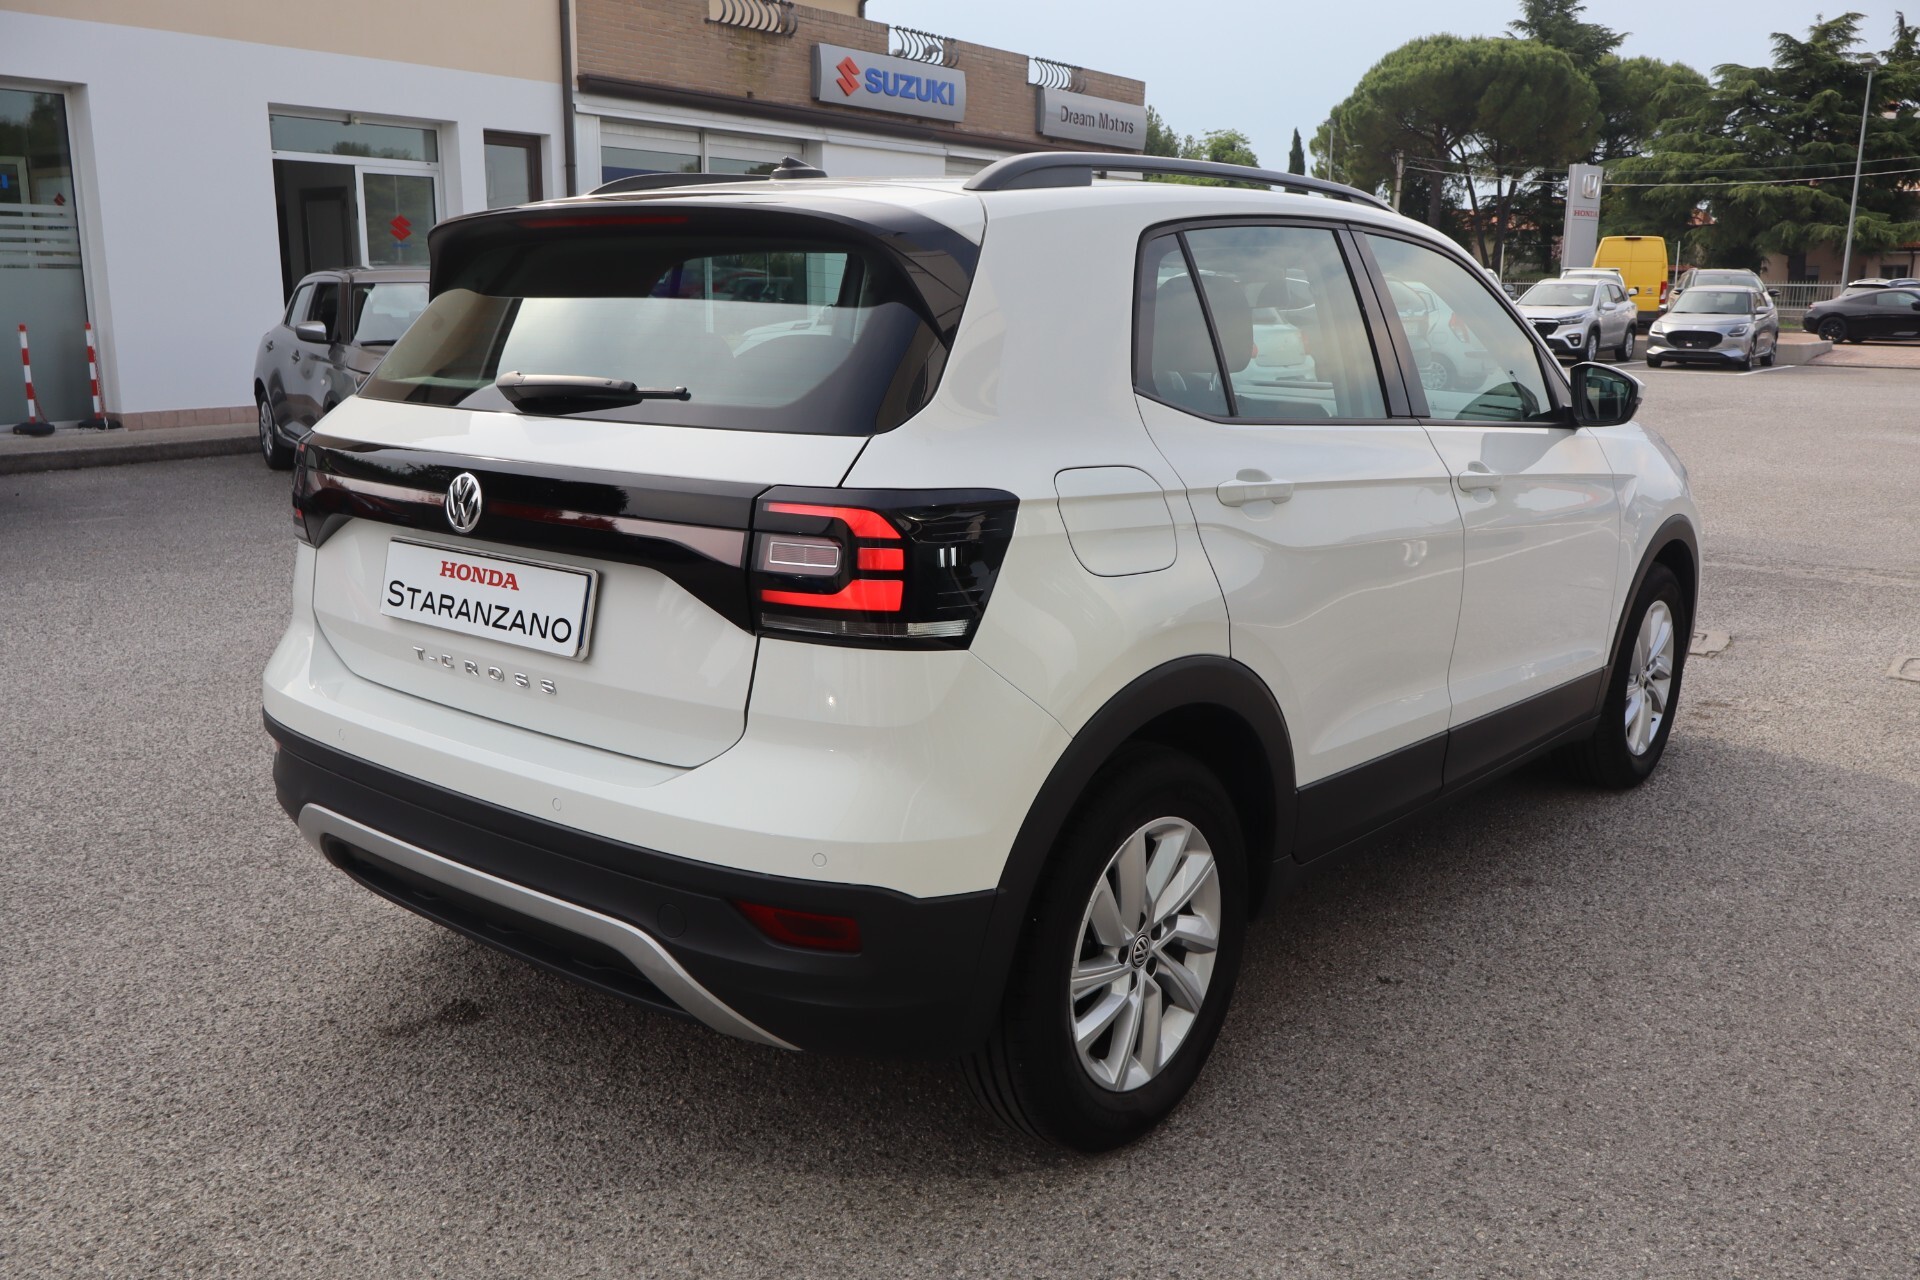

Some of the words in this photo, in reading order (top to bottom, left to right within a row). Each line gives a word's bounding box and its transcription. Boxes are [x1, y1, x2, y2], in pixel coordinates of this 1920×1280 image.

[865, 68, 955, 106] SUZUKI
[1061, 105, 1095, 128] Dream
[1099, 112, 1134, 134] Motors
[440, 561, 519, 591] HONDA
[387, 580, 572, 643] STARANZANO
[413, 646, 557, 695] T-CROSS
